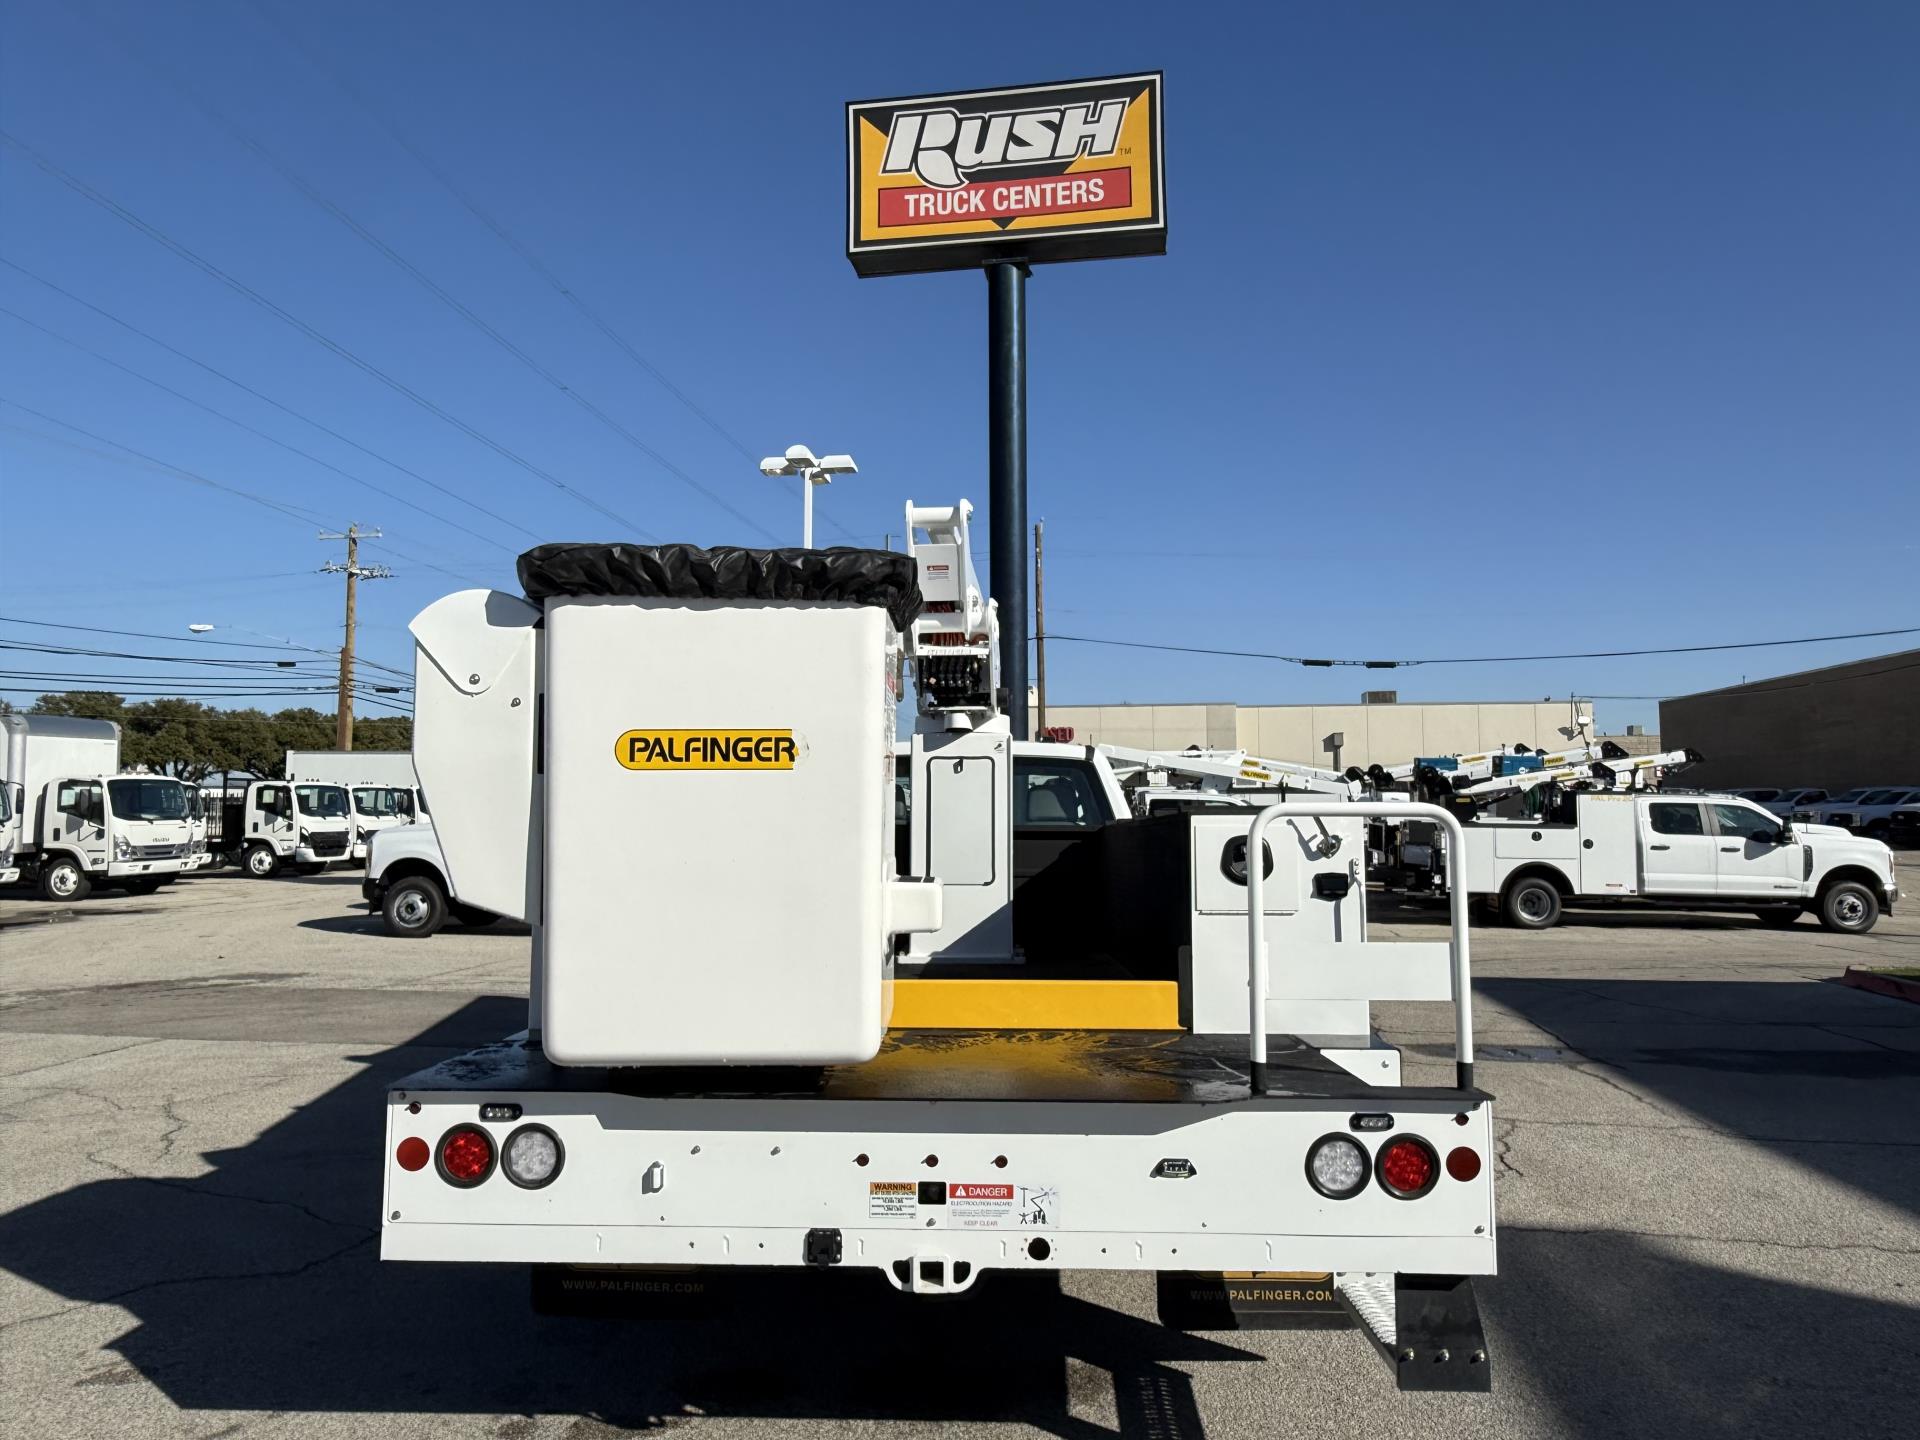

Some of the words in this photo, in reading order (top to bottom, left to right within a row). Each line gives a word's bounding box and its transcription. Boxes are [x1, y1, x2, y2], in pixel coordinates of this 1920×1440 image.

[880, 98, 1129, 189] RUSH
[904, 189, 985, 218] TRUCK
[993, 178, 1105, 211] CENTERS
[628, 737, 796, 763] PALFINGER
[873, 1183, 912, 1191] WARNING
[968, 1187, 1008, 1197] DANGER
